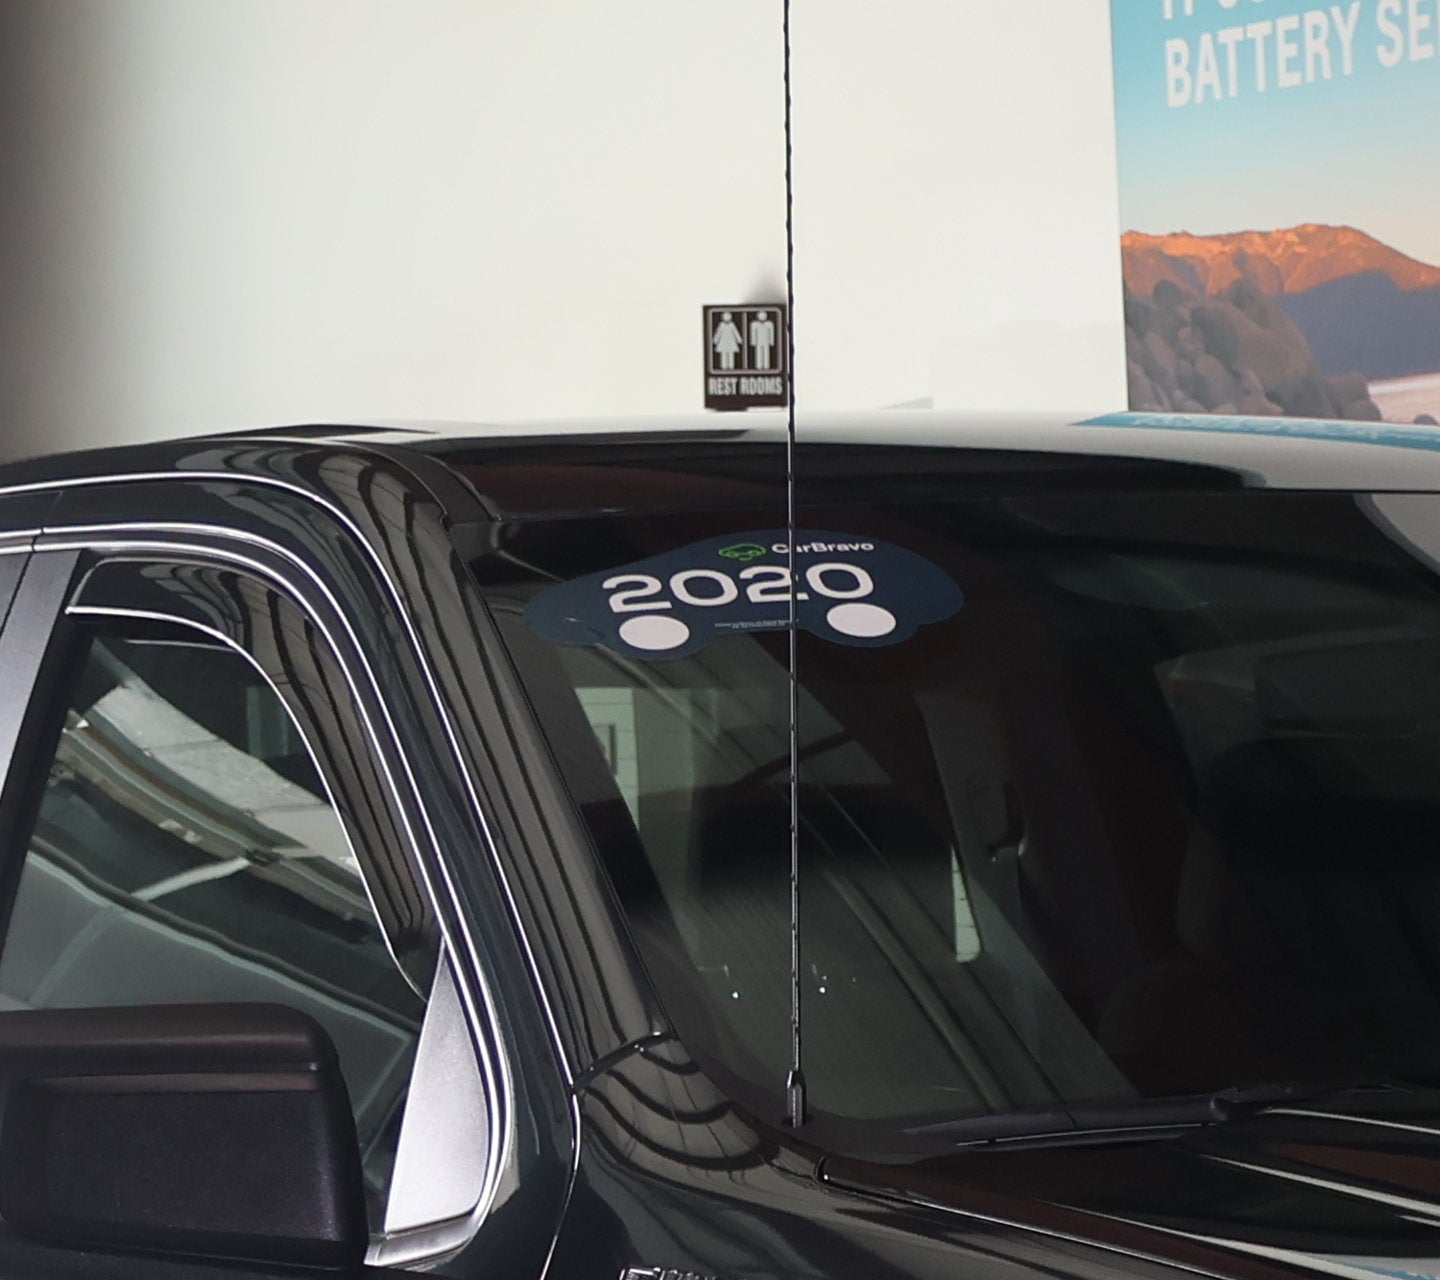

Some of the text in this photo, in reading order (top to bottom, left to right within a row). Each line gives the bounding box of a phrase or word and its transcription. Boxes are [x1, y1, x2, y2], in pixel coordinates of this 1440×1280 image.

[1165, 2, 1358, 107] BATTERY
[708, 376, 783, 395] REST ROOMS
[601, 563, 875, 613] 2020
